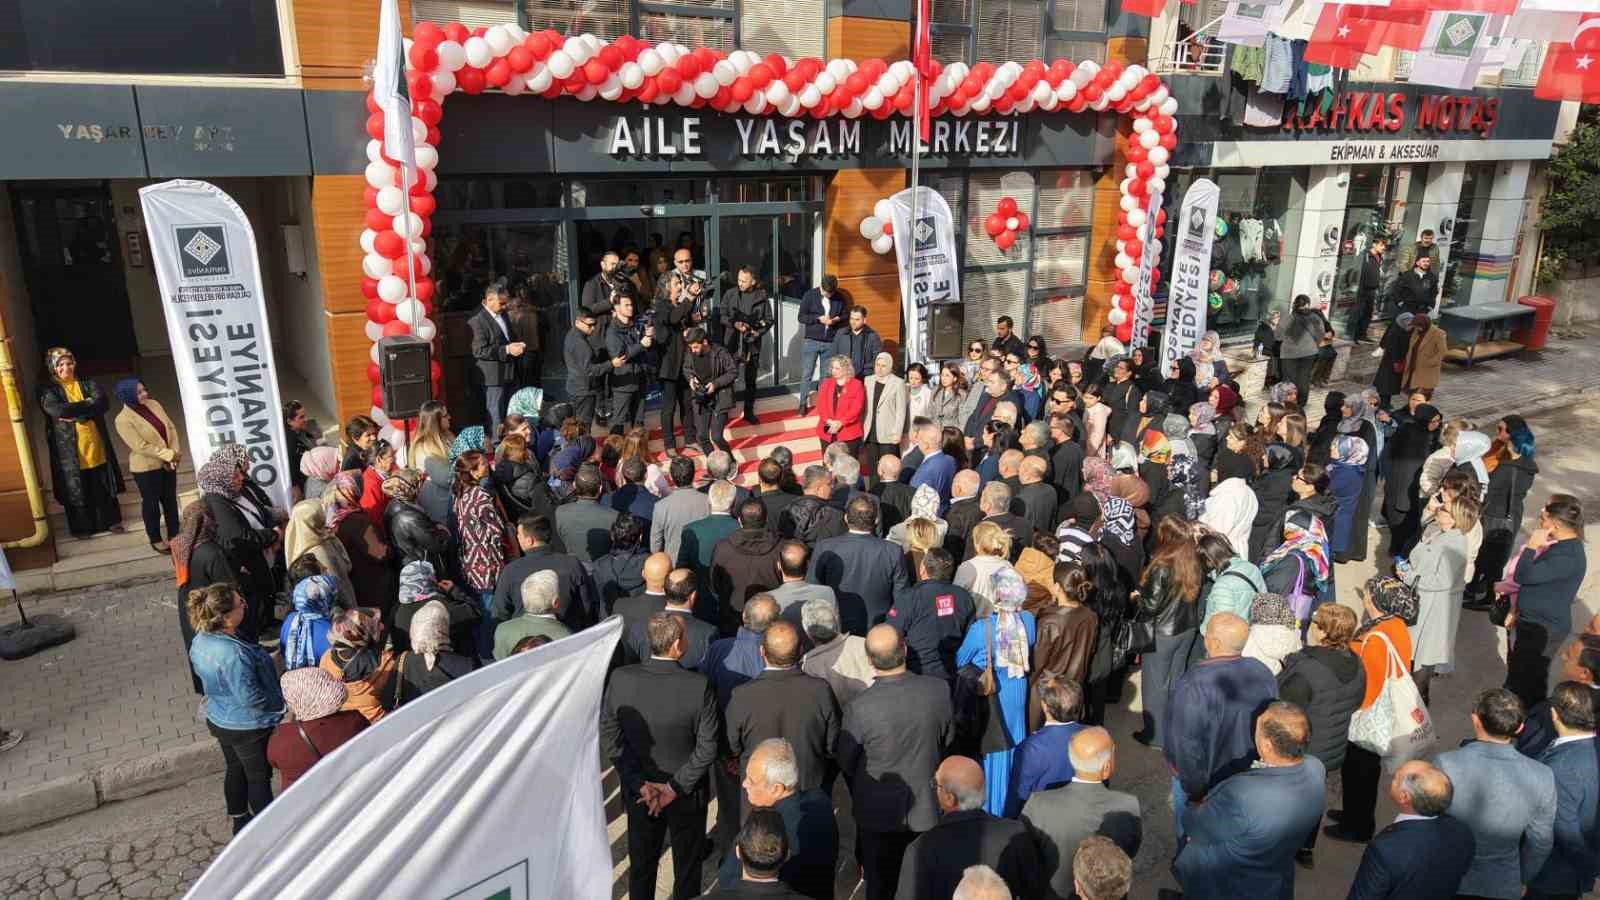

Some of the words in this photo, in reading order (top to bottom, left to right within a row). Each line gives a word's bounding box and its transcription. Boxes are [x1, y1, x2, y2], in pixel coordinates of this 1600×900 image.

[57, 123, 131, 144] YAŞAR
[609, 103, 701, 155] AİLE
[735, 118, 861, 163] YAŞAM
[1417, 94, 1502, 137] MOTAŞ
[1330, 141, 1375, 160] EKİPMAN
[1378, 146, 1385, 159] &
[1389, 144, 1440, 160] AKSESUAR
[1167, 263, 1188, 361] OSMANİYE
